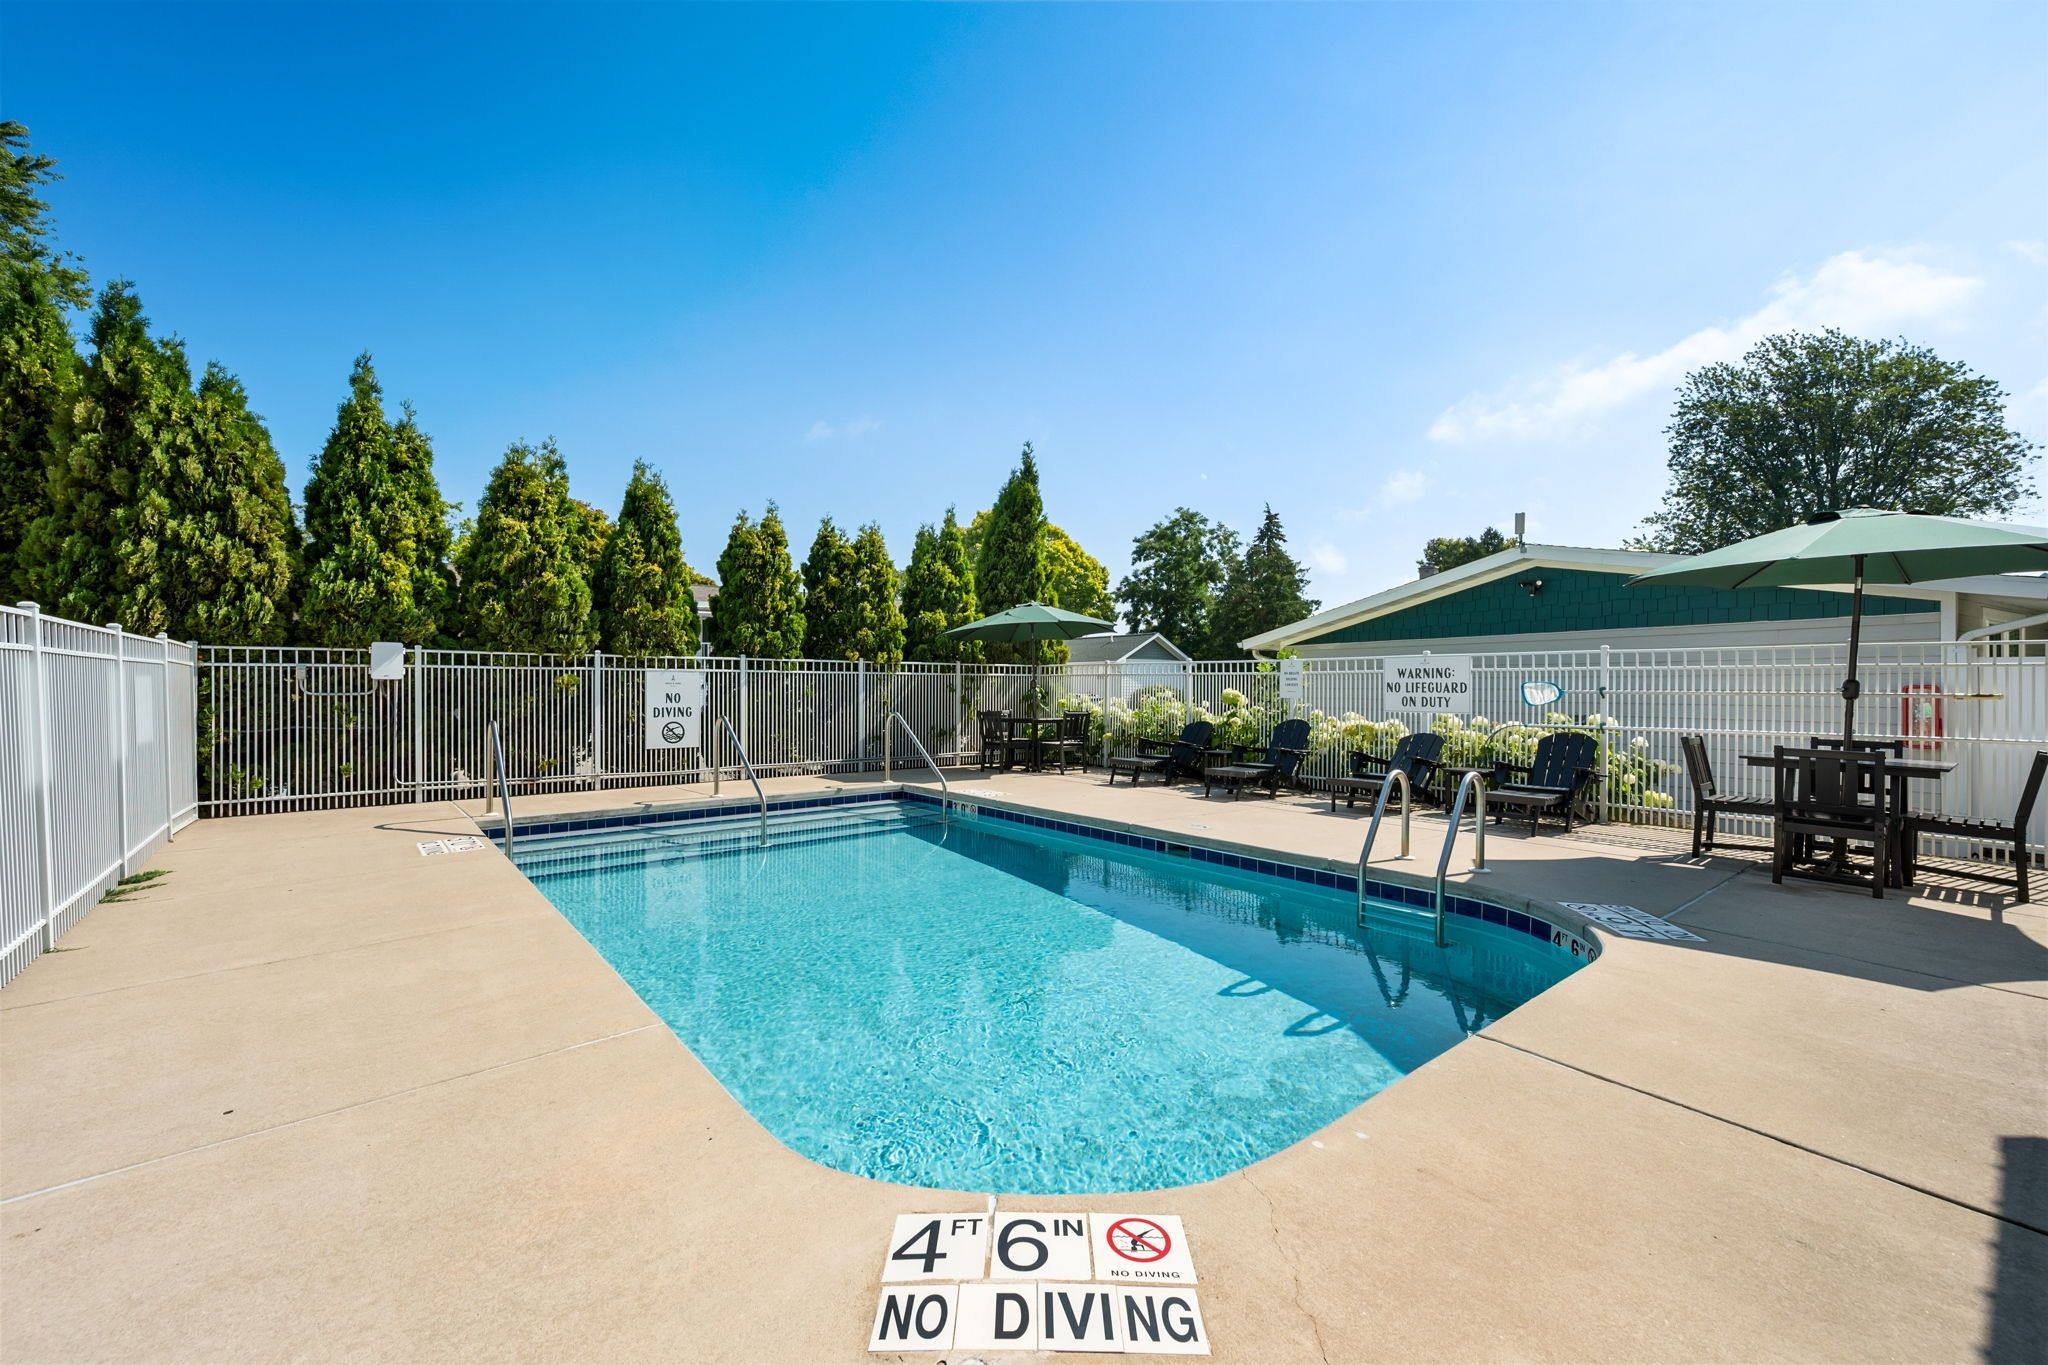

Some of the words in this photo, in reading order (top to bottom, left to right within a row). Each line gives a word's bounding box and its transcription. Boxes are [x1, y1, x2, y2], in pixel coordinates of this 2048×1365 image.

[1397, 667, 1456, 679] WARNING:
[1386, 682, 1401, 693] NO
[1405, 682, 1468, 694] LIFEGUARD
[665, 692, 681, 704] NO
[1401, 696, 1417, 707] ON
[1421, 696, 1451, 708] DUTY
[653, 706, 692, 718] DIVING
[1553, 931, 1562, 947] 4
[1571, 939, 1579, 957] 6
[891, 1219, 948, 1273] 4
[951, 1218, 984, 1236] FT
[996, 1218, 1049, 1272] 6
[1053, 1219, 1084, 1237] IN
[1110, 1269, 1131, 1279] NO
[1135, 1270, 1181, 1279] DIVING
[878, 1293, 949, 1341] NO
[994, 1291, 1199, 1343] DIVING
